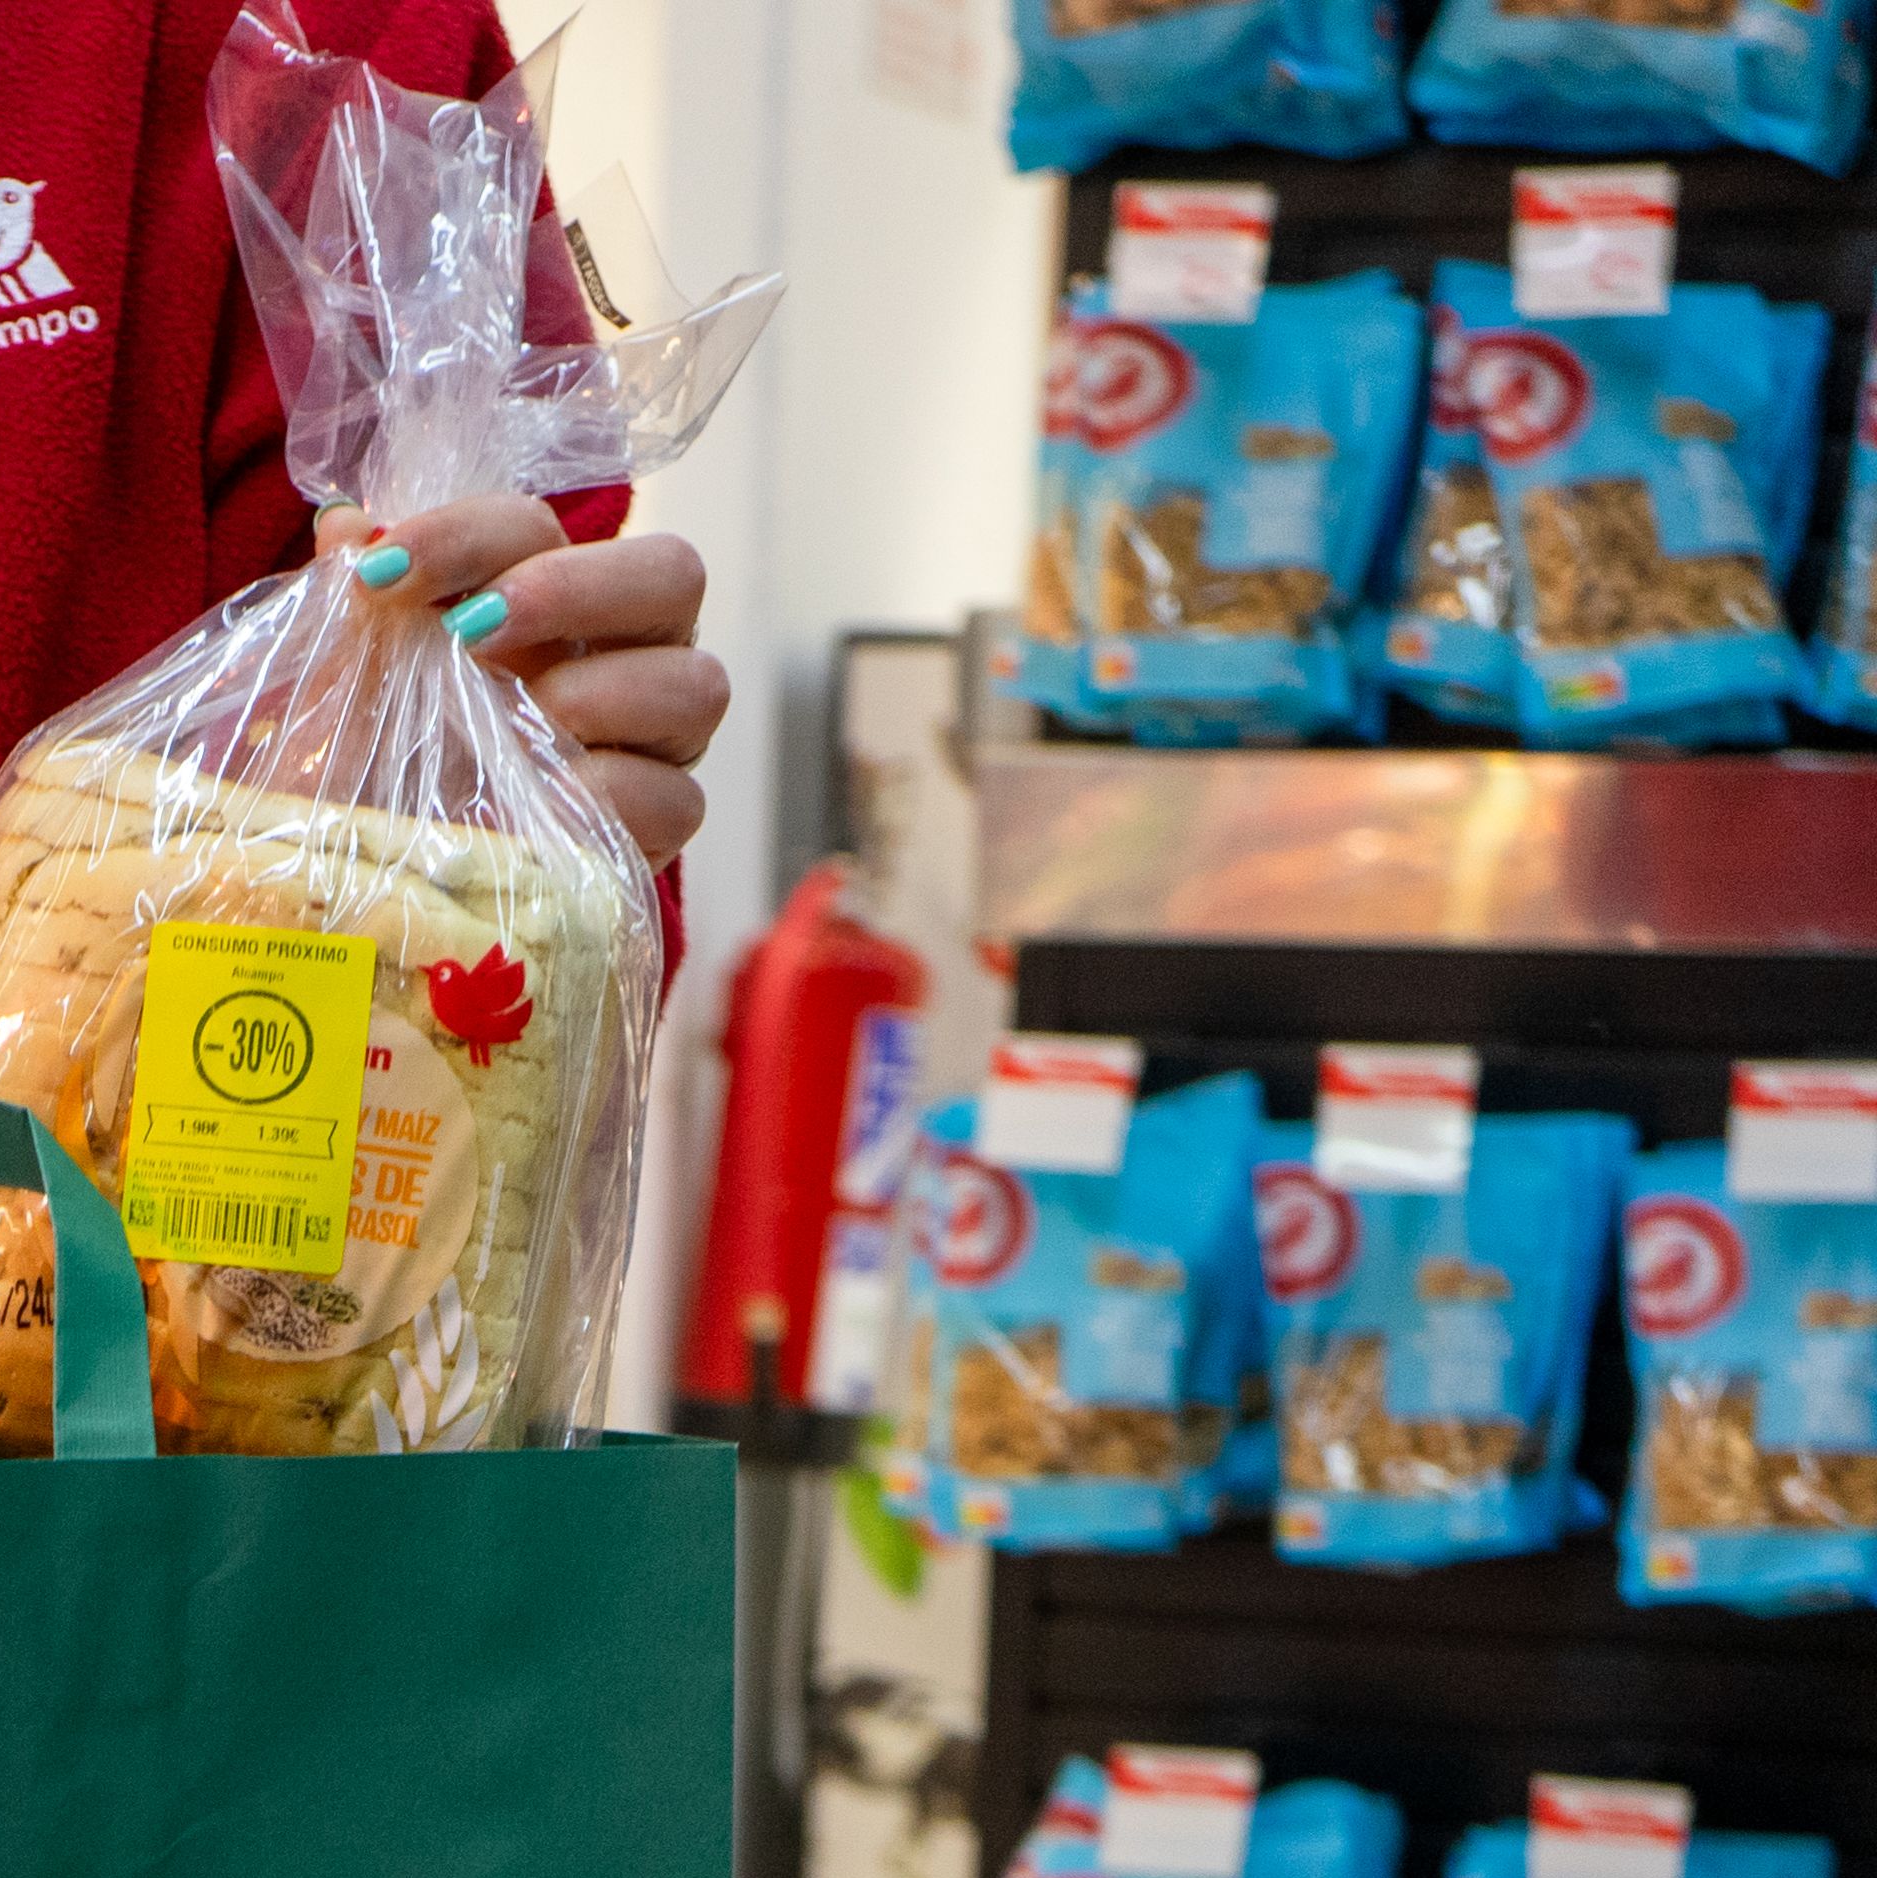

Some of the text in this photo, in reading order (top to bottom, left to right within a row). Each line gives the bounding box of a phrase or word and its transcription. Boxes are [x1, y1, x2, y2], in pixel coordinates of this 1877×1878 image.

[173, 935, 348, 963] CONSUMO PRÓXIMO
[232, 966, 285, 983] Alcampo
[373, 1107, 443, 1148] MAÍZ
[345, 1206, 421, 1251] RASOL
